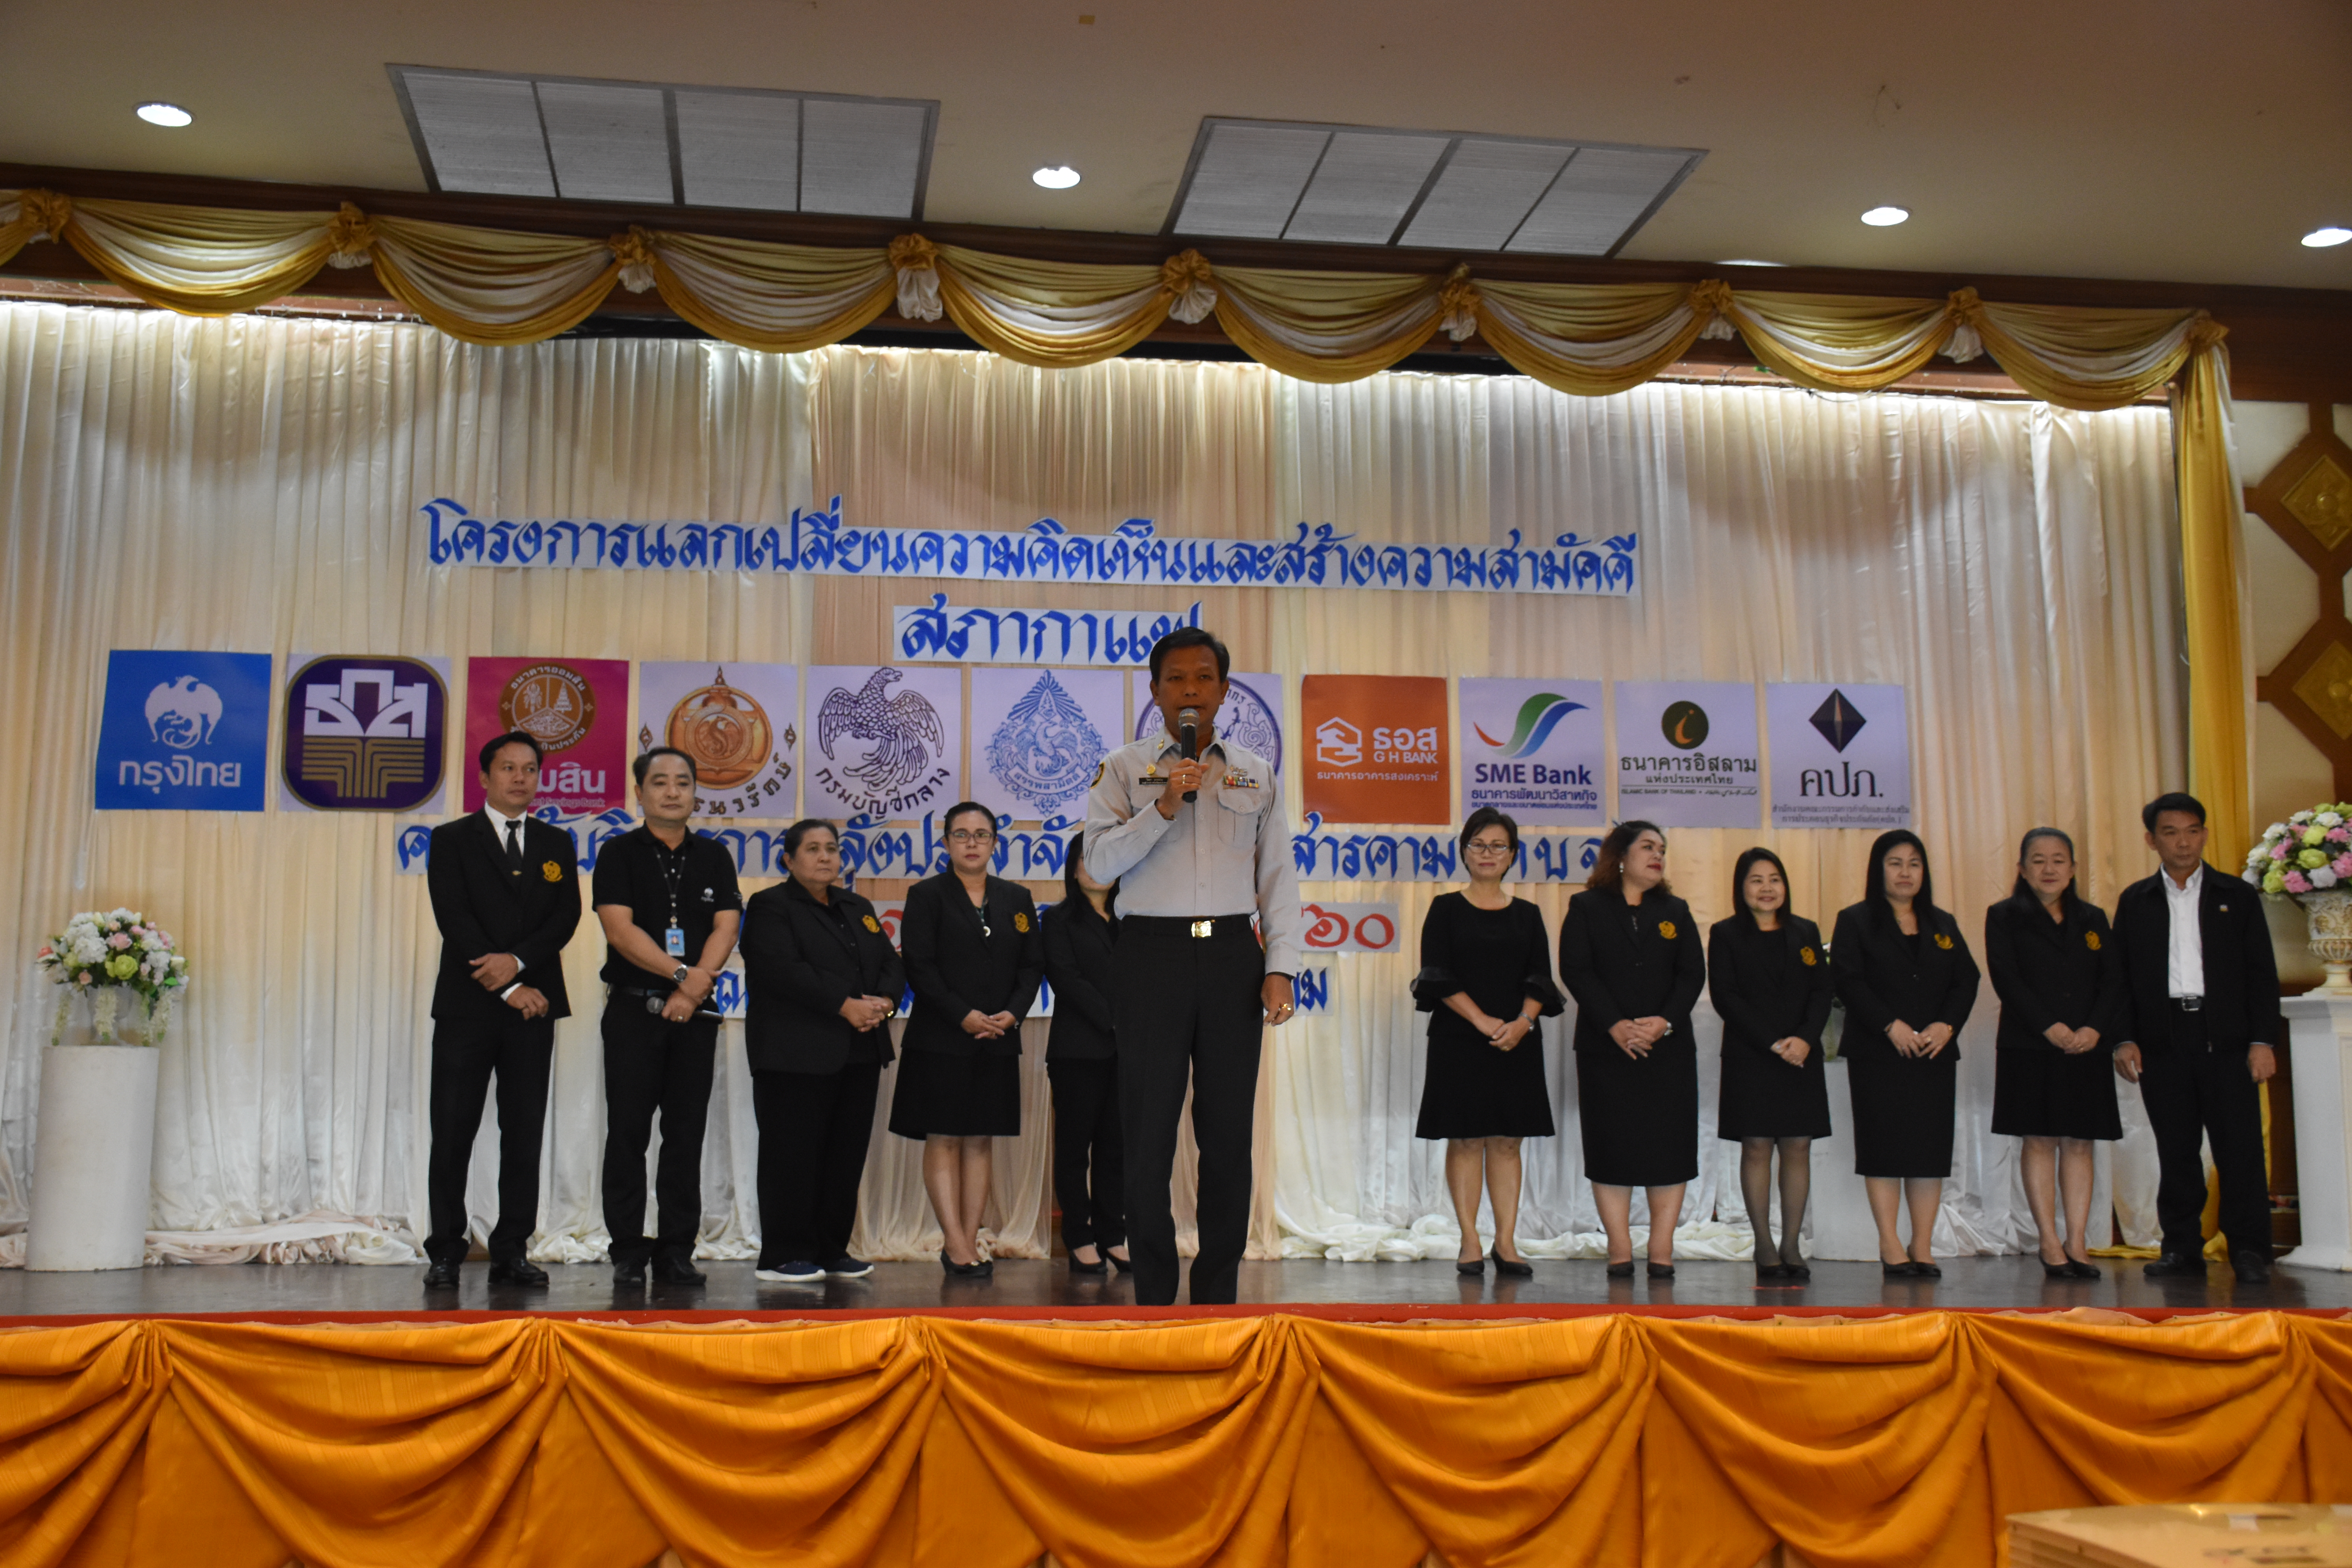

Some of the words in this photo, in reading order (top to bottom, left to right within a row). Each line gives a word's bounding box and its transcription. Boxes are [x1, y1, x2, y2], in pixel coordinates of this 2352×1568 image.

[1373, 727, 1437, 751] ธอส
[1403, 752, 1438, 764] BANK
[1621, 752, 1757, 772] ธนาคารอิสลาม
[119, 755, 241, 794] กรุงไทย
[537, 761, 606, 793] มสิน
[694, 752, 791, 815] ธนารักษ์
[1317, 771, 1439, 781] ธนาคารอาคารสงเคราะห์
[1475, 763, 1526, 784] SME
[1533, 764, 1592, 785] Bank
[1646, 773, 1733, 784] แห่งประเทศไทย
[816, 768, 950, 819] กรมบัญชีกลาง
[1471, 788, 1598, 801] ธนาคารพัฒนาวิสาหกิจ
[1301, 903, 1395, 949] ๖๐
